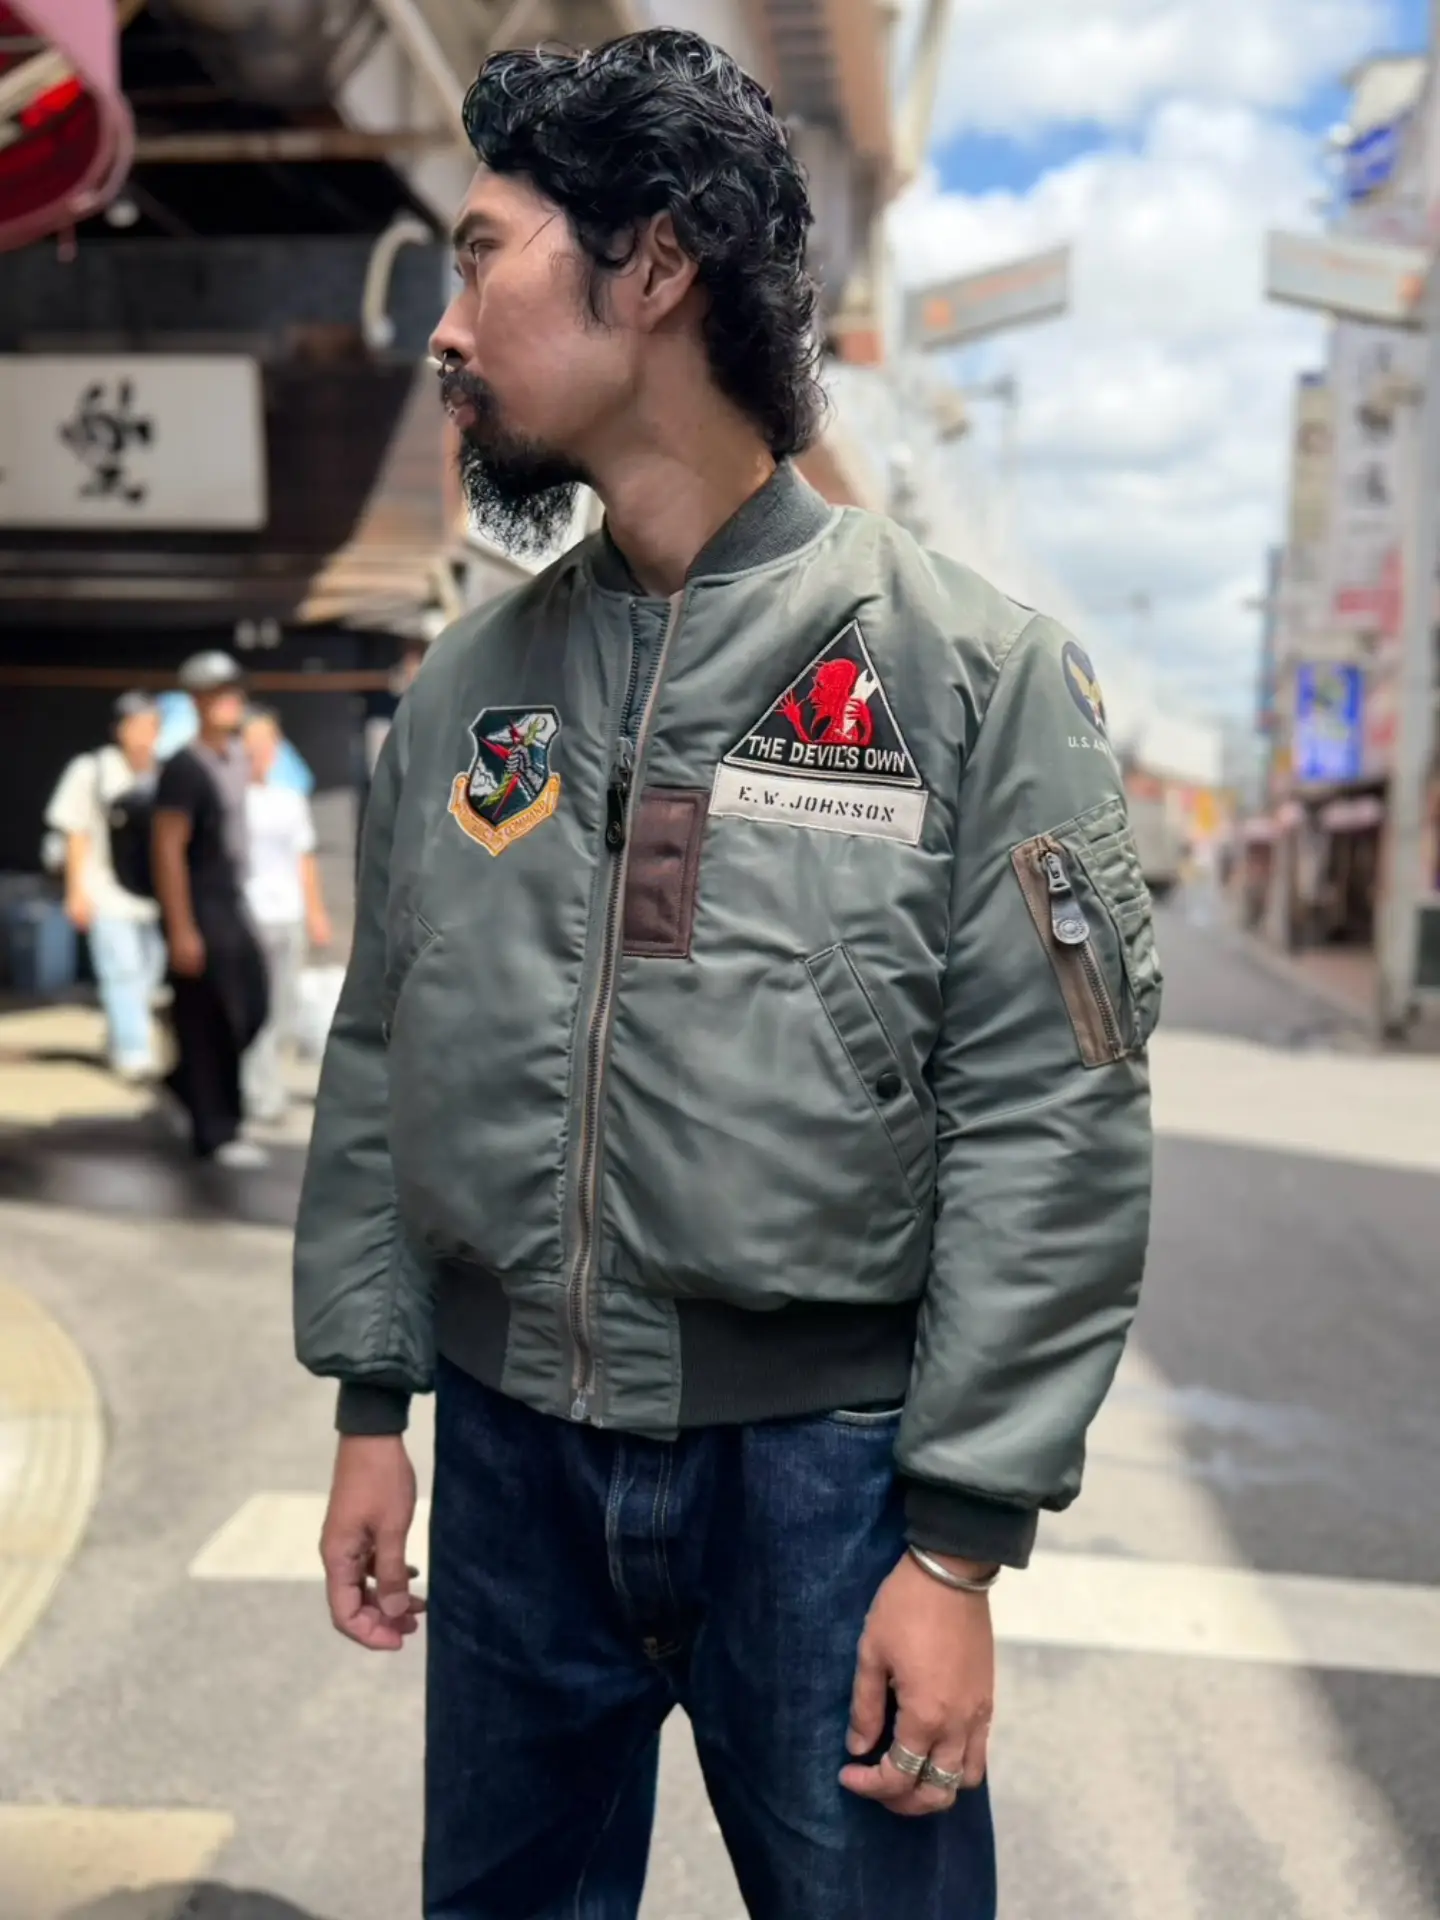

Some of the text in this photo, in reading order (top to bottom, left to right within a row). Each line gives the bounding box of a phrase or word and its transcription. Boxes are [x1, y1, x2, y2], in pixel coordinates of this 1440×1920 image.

[1068, 736, 1090, 748] U.S.
[748, 736, 786, 760] THE
[864, 748, 906, 773] OWN
